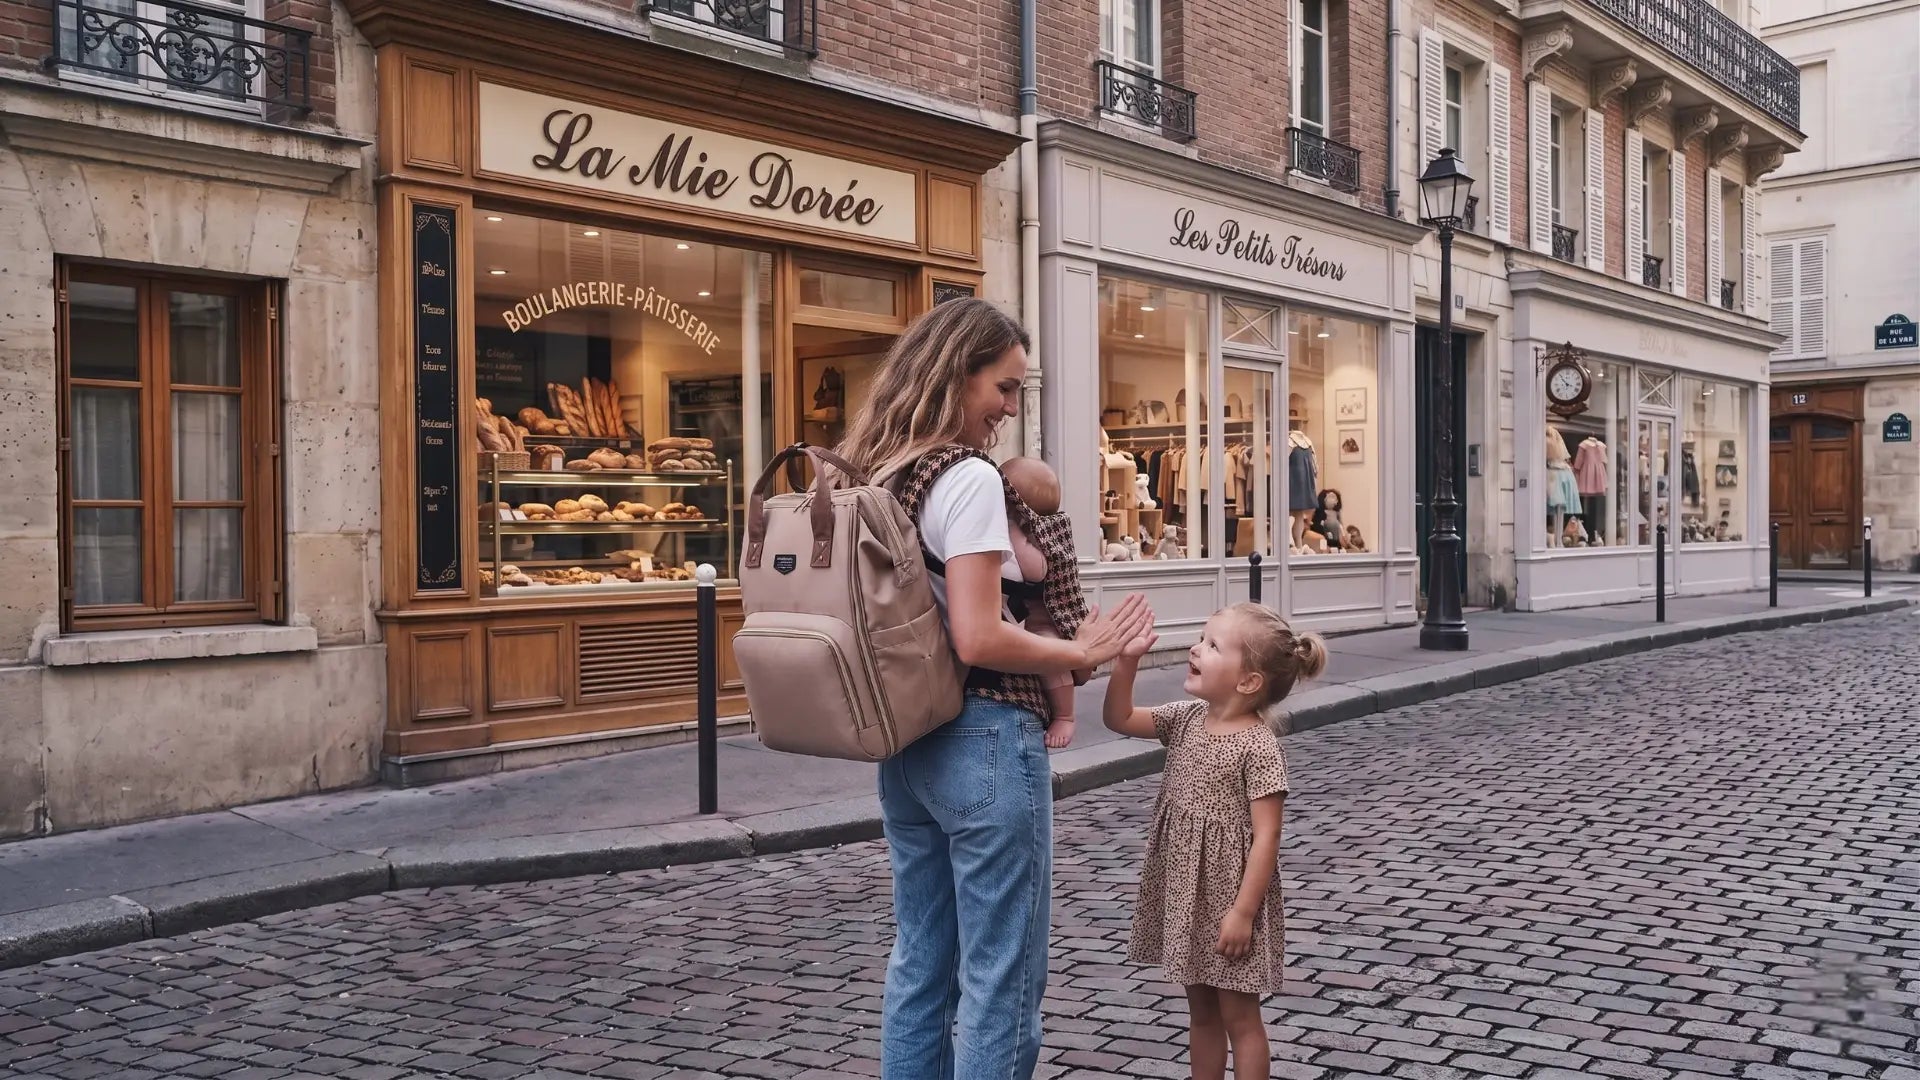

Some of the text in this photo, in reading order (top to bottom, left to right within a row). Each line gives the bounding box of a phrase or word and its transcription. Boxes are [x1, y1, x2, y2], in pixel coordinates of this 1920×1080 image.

[532, 109, 884, 226] La Mie Dorée
[1169, 207, 1347, 281] Les Petits Trésors
[1793, 394, 1806, 404] 12
